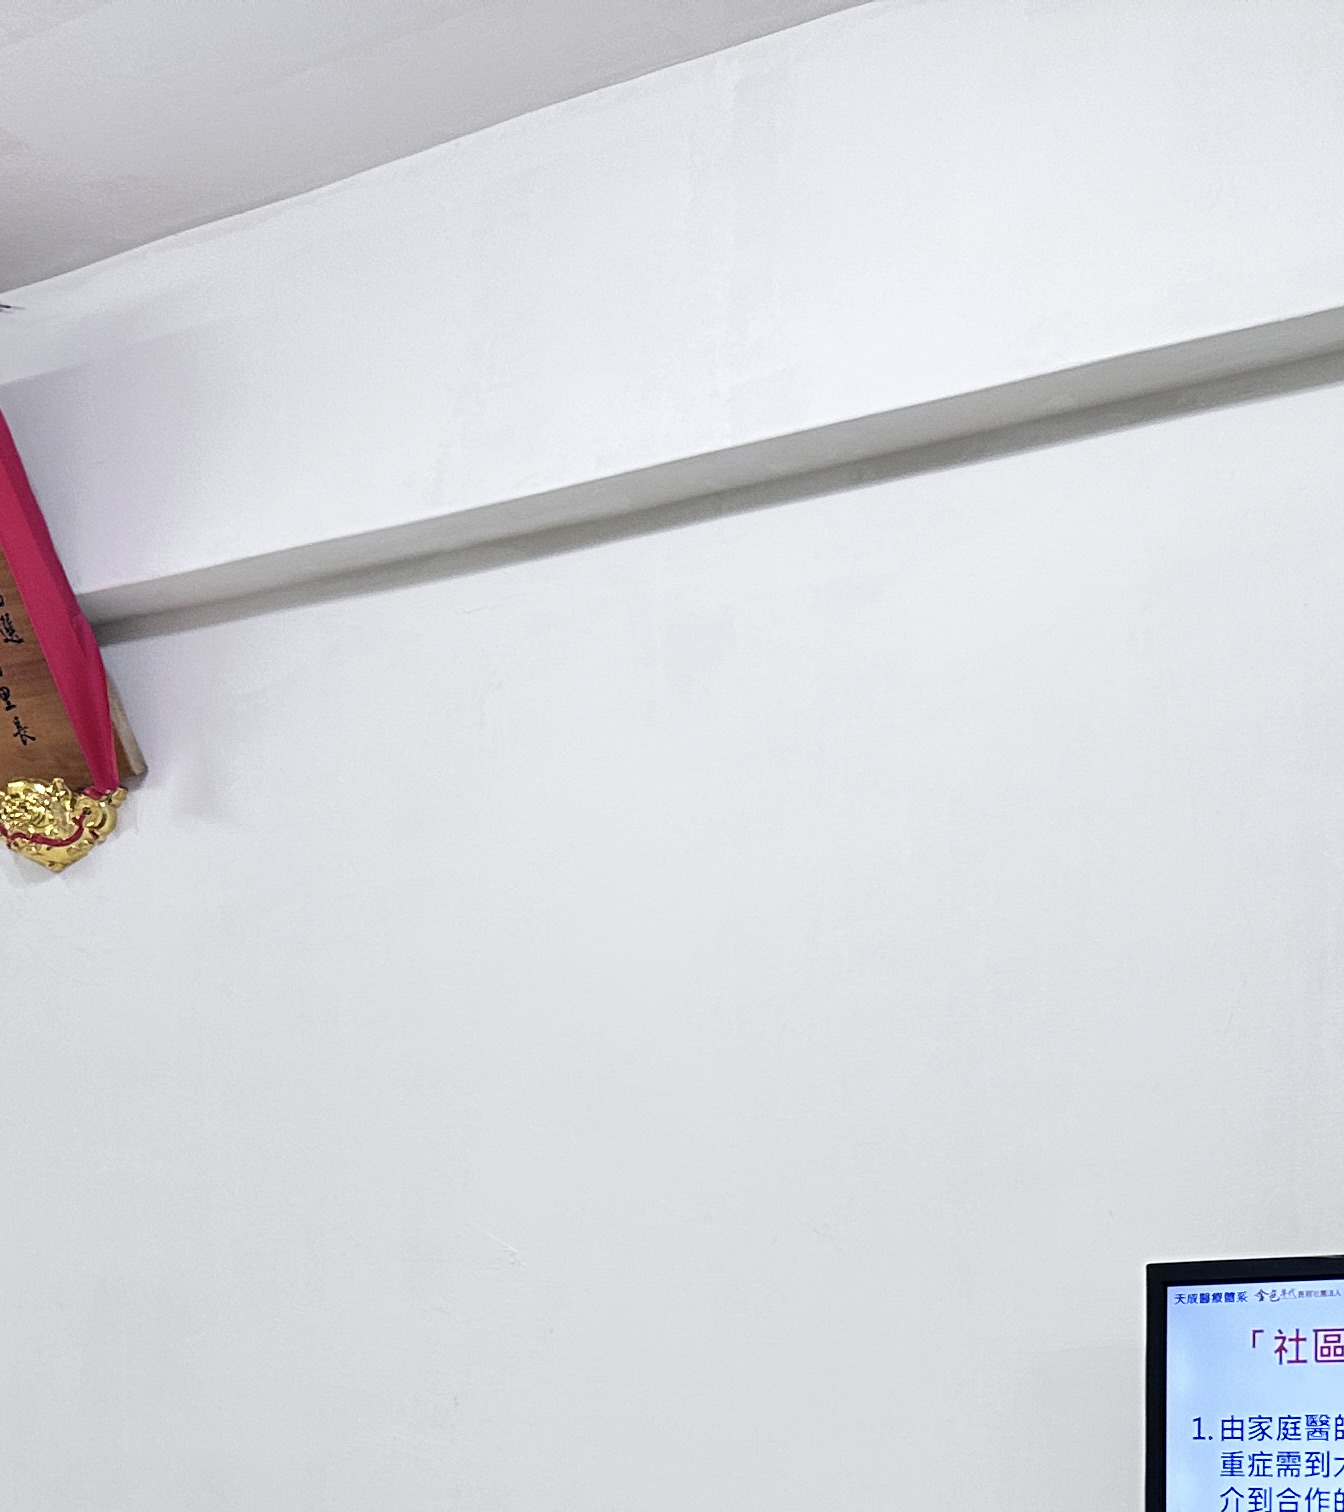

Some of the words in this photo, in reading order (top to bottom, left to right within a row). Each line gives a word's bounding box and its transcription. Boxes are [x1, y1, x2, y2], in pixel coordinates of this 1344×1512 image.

[1174, 1290, 1249, 1305] 天成醫療體系
